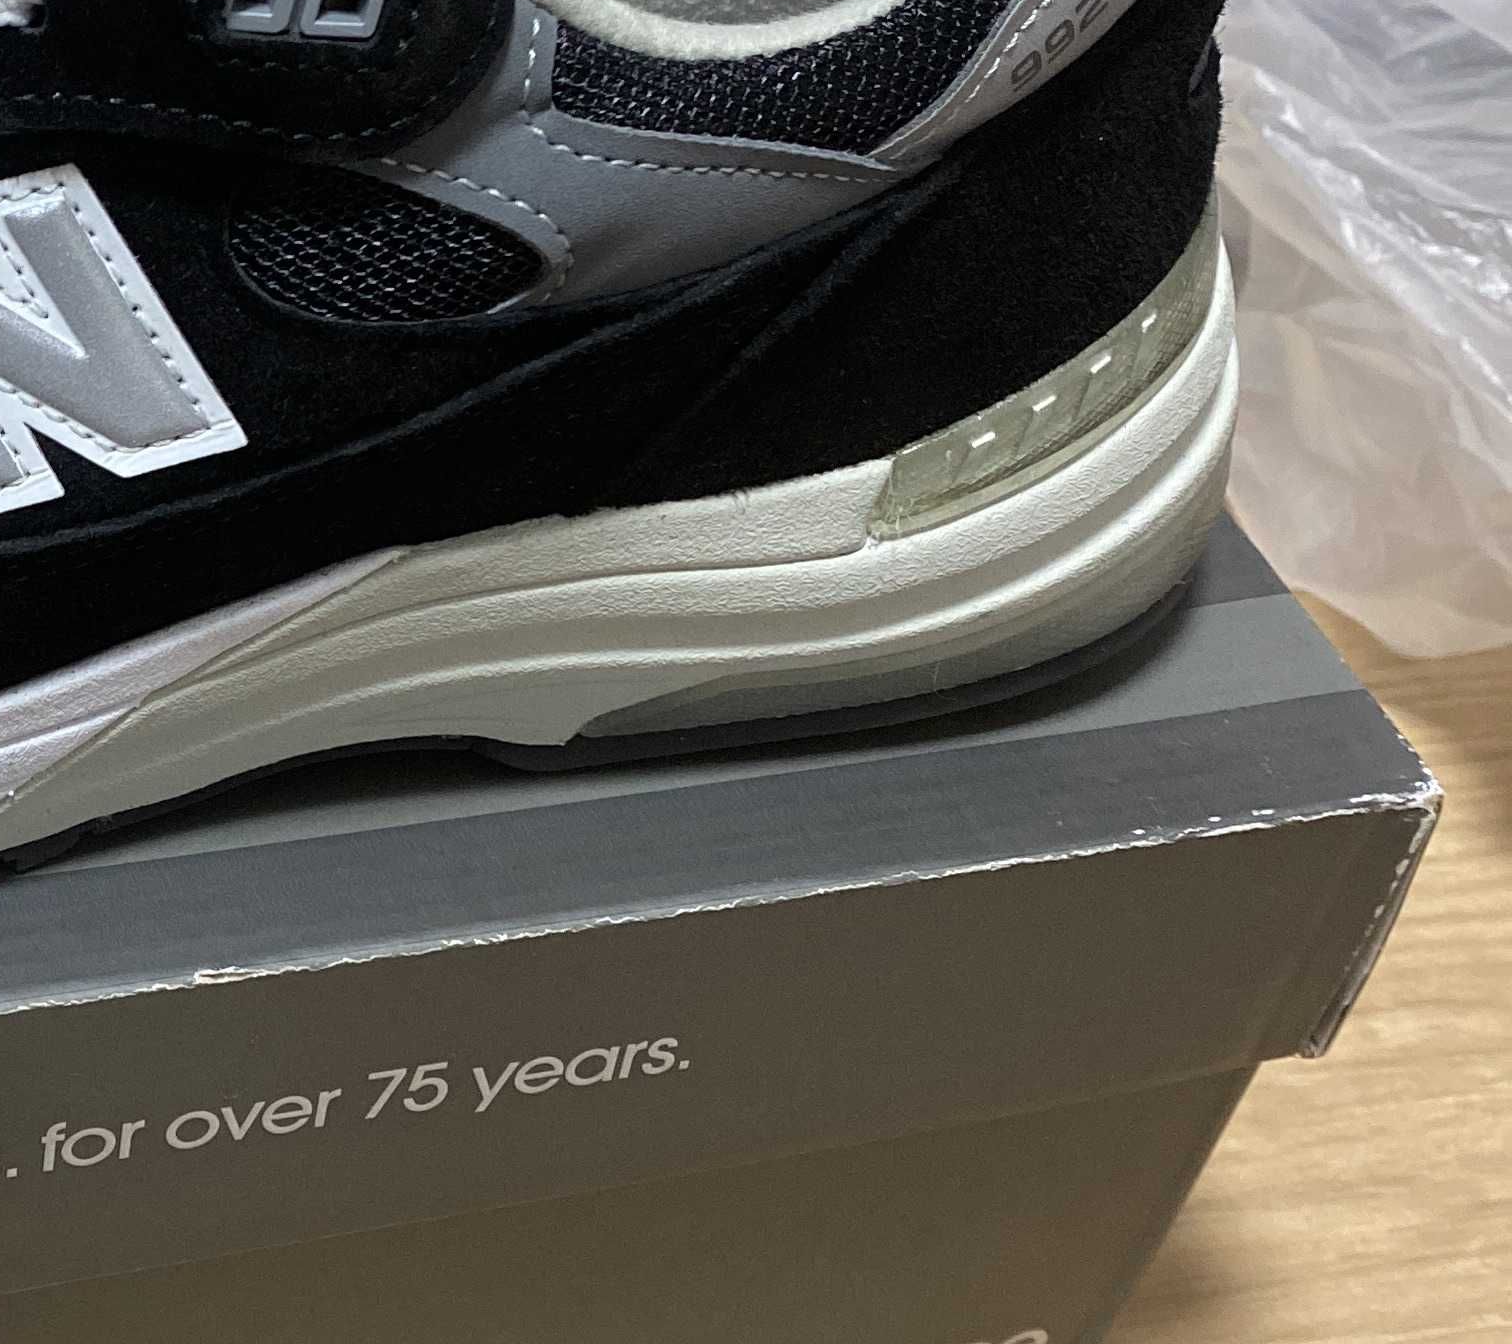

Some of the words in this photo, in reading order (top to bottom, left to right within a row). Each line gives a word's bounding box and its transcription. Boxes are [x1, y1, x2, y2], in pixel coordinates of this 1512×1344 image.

[40, 1120, 147, 1173] for
[164, 1087, 343, 1150] over
[363, 1060, 450, 1121] 75
[471, 1036, 691, 1114] years.
